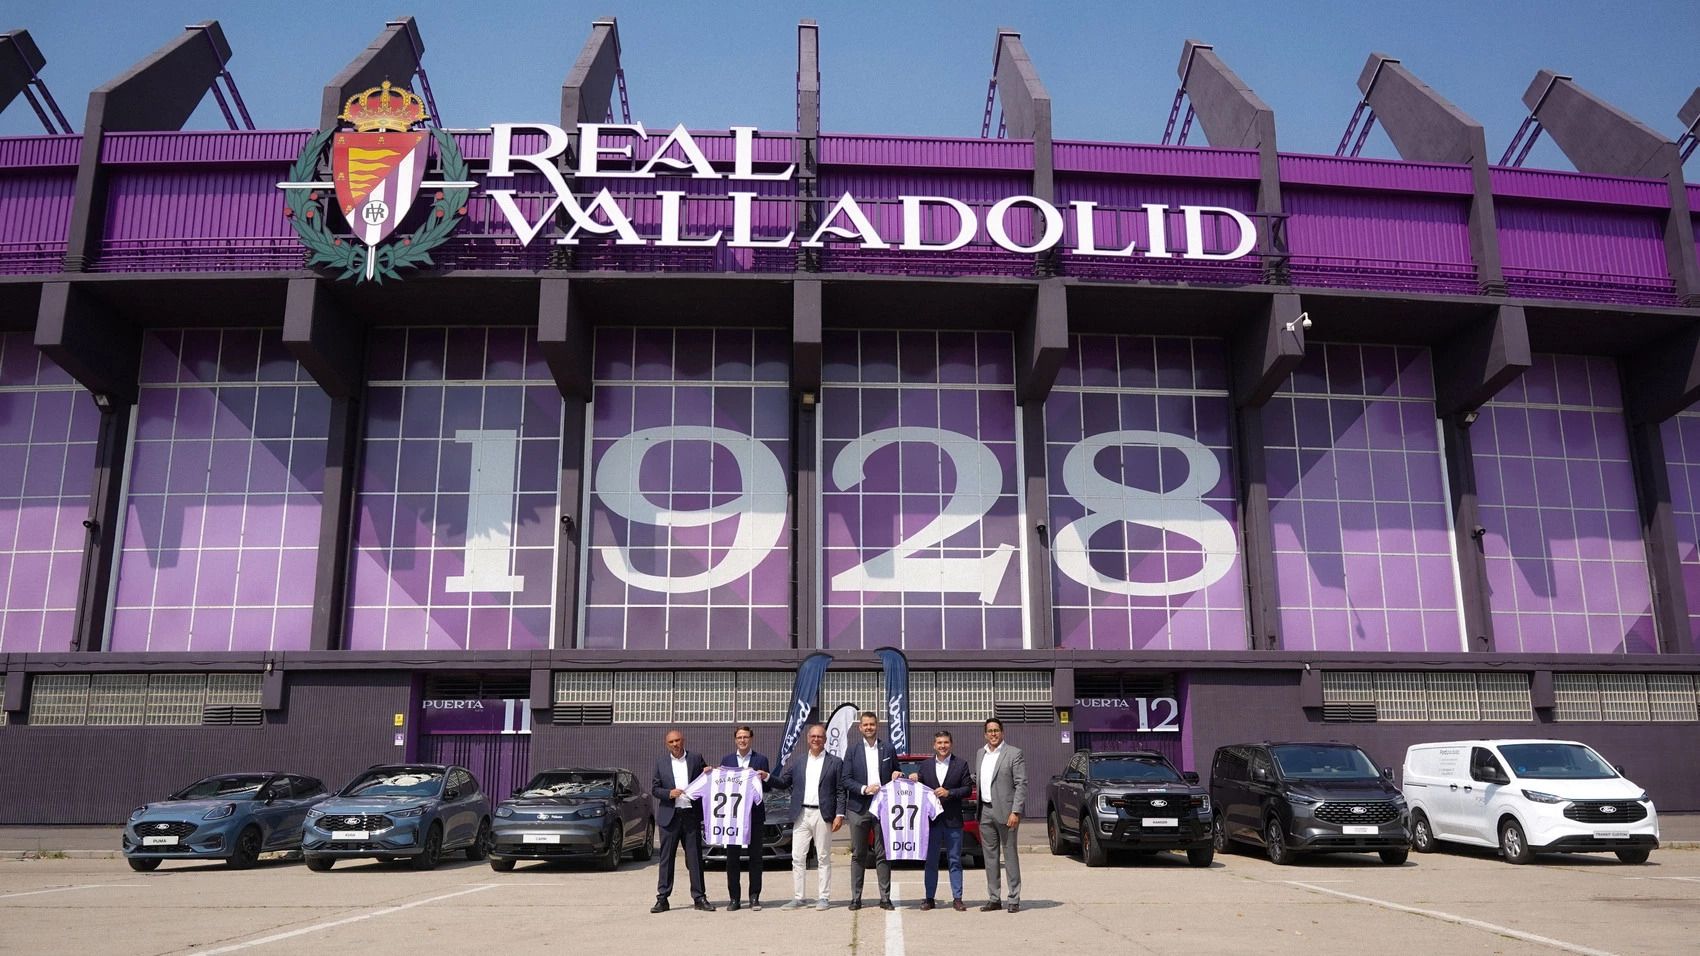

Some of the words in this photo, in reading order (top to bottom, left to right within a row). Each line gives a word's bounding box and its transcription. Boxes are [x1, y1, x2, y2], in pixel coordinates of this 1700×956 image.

[486, 121, 794, 234] REAL
[486, 187, 1257, 261] VALLADOLID
[445, 424, 1238, 604] 1928
[422, 700, 484, 709] PUERTA
[501, 699, 532, 734] 11
[1135, 698, 1179, 732] 12
[781, 698, 811, 767] Ford
[713, 792, 743, 819] 27
[891, 804, 919, 831] 27
[713, 826, 739, 836] DIGI
[893, 842, 916, 852] DIGI
